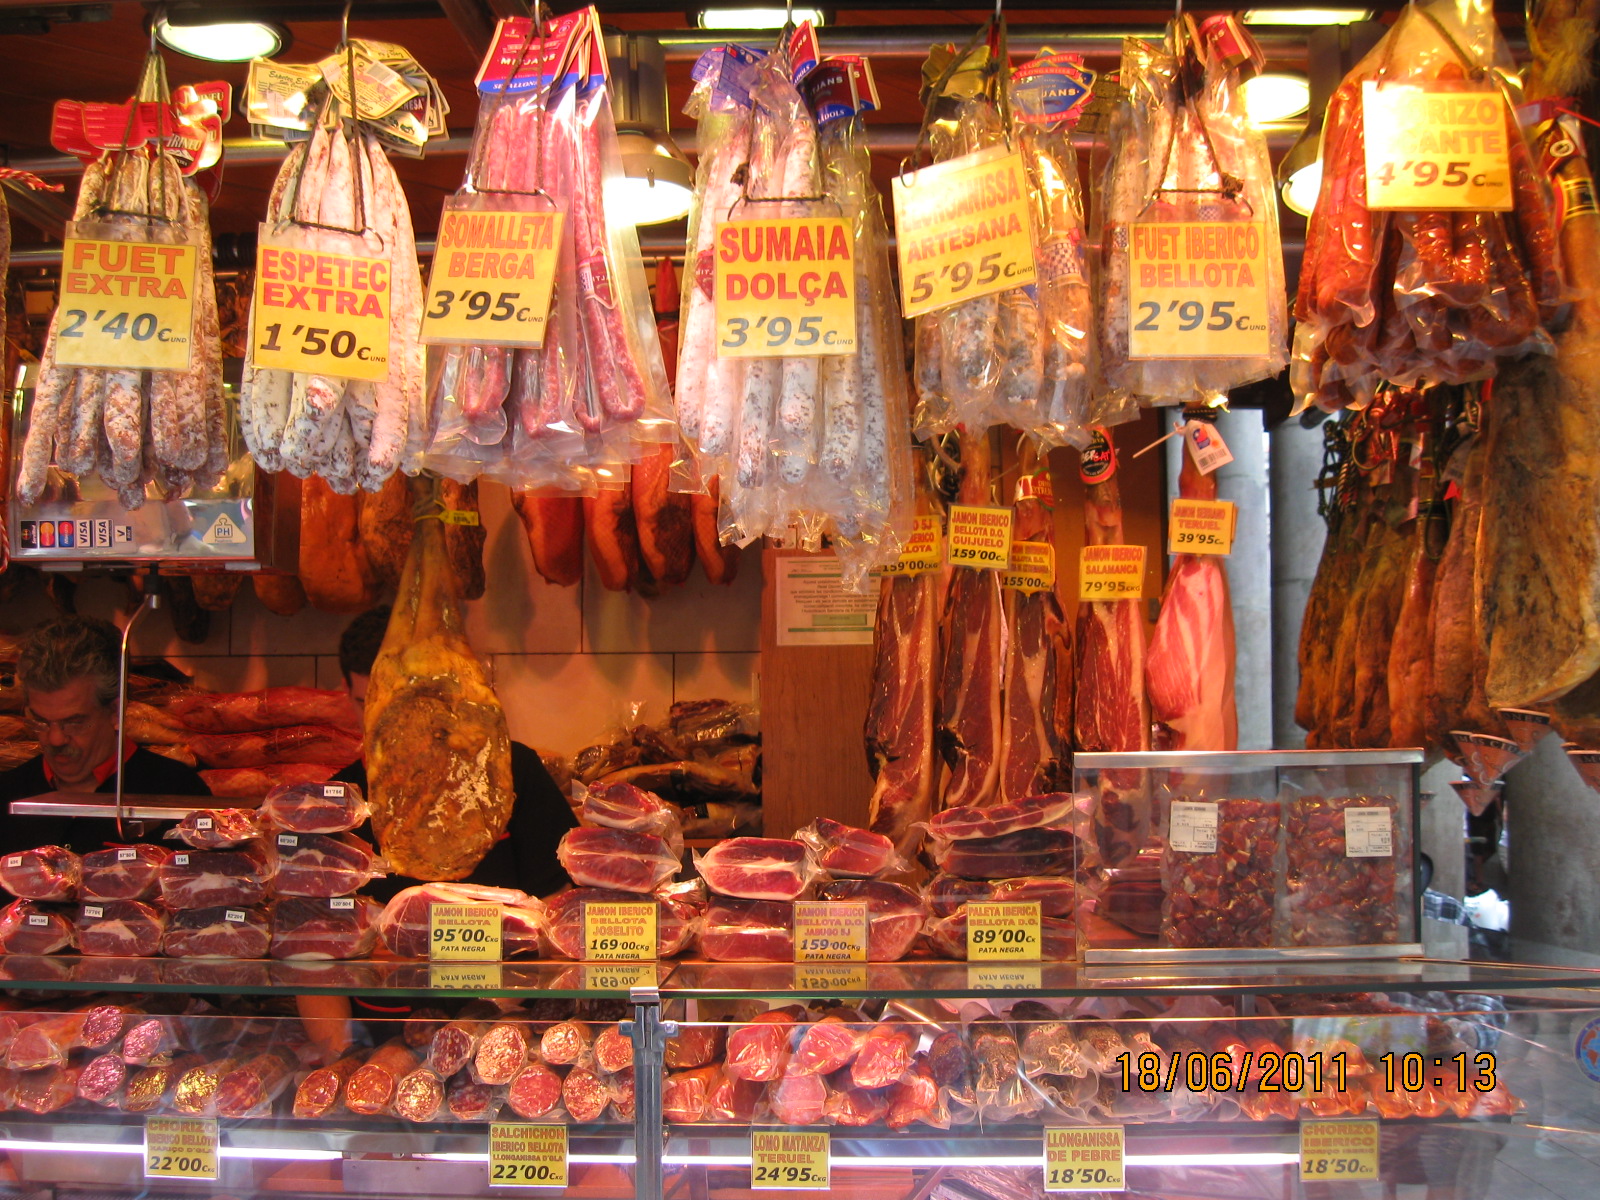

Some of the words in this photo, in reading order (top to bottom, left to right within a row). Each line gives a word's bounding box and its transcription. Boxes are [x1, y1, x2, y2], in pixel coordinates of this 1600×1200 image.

[501, 54, 556, 65] MIJANS
[493, 81, 539, 89] SEALLON
[1042, 89, 1076, 97] JANS
[442, 214, 554, 250] SOMALLETA
[907, 212, 1022, 264] ARTESANA
[720, 226, 850, 263] SUMAIA
[1134, 226, 1181, 260] FUET
[1186, 226, 1260, 260] IBERICO
[73, 242, 185, 275] FUET
[262, 249, 387, 293] ESPETEC
[448, 252, 535, 280] BERGA
[1140, 263, 1255, 288] BELLOTA
[66, 273, 187, 299] EXTRA
[726, 272, 848, 307] DOLÇA
[264, 282, 384, 319] EXTRA
[952, 512, 978, 526] JAMON
[979, 513, 1009, 528] IBERICO
[1178, 519, 1221, 531] TERUEL
[80, 522, 88, 544] VISA
[99, 522, 107, 544] VISA
[217, 528, 230, 536] PH
[954, 525, 988, 537] BELLOTA
[909, 532, 934, 544] ERICO
[953, 536, 1004, 548] GUIJUELO
[902, 545, 932, 554] LOTA
[1084, 547, 1111, 562] JAMON
[1112, 548, 1143, 562] IBERICO
[1086, 564, 1138, 575] SALAMANCA
[434, 907, 463, 918] JAMON
[464, 907, 499, 918] IBERICO
[587, 906, 617, 917] JAMON
[618, 906, 654, 916] IBERICO
[797, 908, 827, 917] JAMON
[830, 908, 865, 917] IBERICO
[969, 907, 1001, 917] PALETA
[1003, 906, 1038, 916] IBERICA
[593, 926, 644, 937] JOSELITO
[805, 928, 838, 936] JABUGO
[149, 1120, 216, 1134] CHORIZO
[492, 1127, 565, 1139] SALCHICHON
[1303, 1125, 1376, 1135] CHORIZO
[753, 1135, 781, 1152] LOMO
[782, 1135, 826, 1152] MATANZA
[1047, 1133, 1121, 1148] LLONGANISSA
[1304, 1137, 1375, 1147] IBERICO
[492, 1141, 526, 1152] IBERICO
[528, 1142, 564, 1153] BELLOTA
[493, 1154, 541, 1162] LLONGANISSA
[758, 1154, 815, 1164] TERUEL
[1048, 1150, 1067, 1162] DE
[1071, 1150, 1121, 1162] PEBRE
